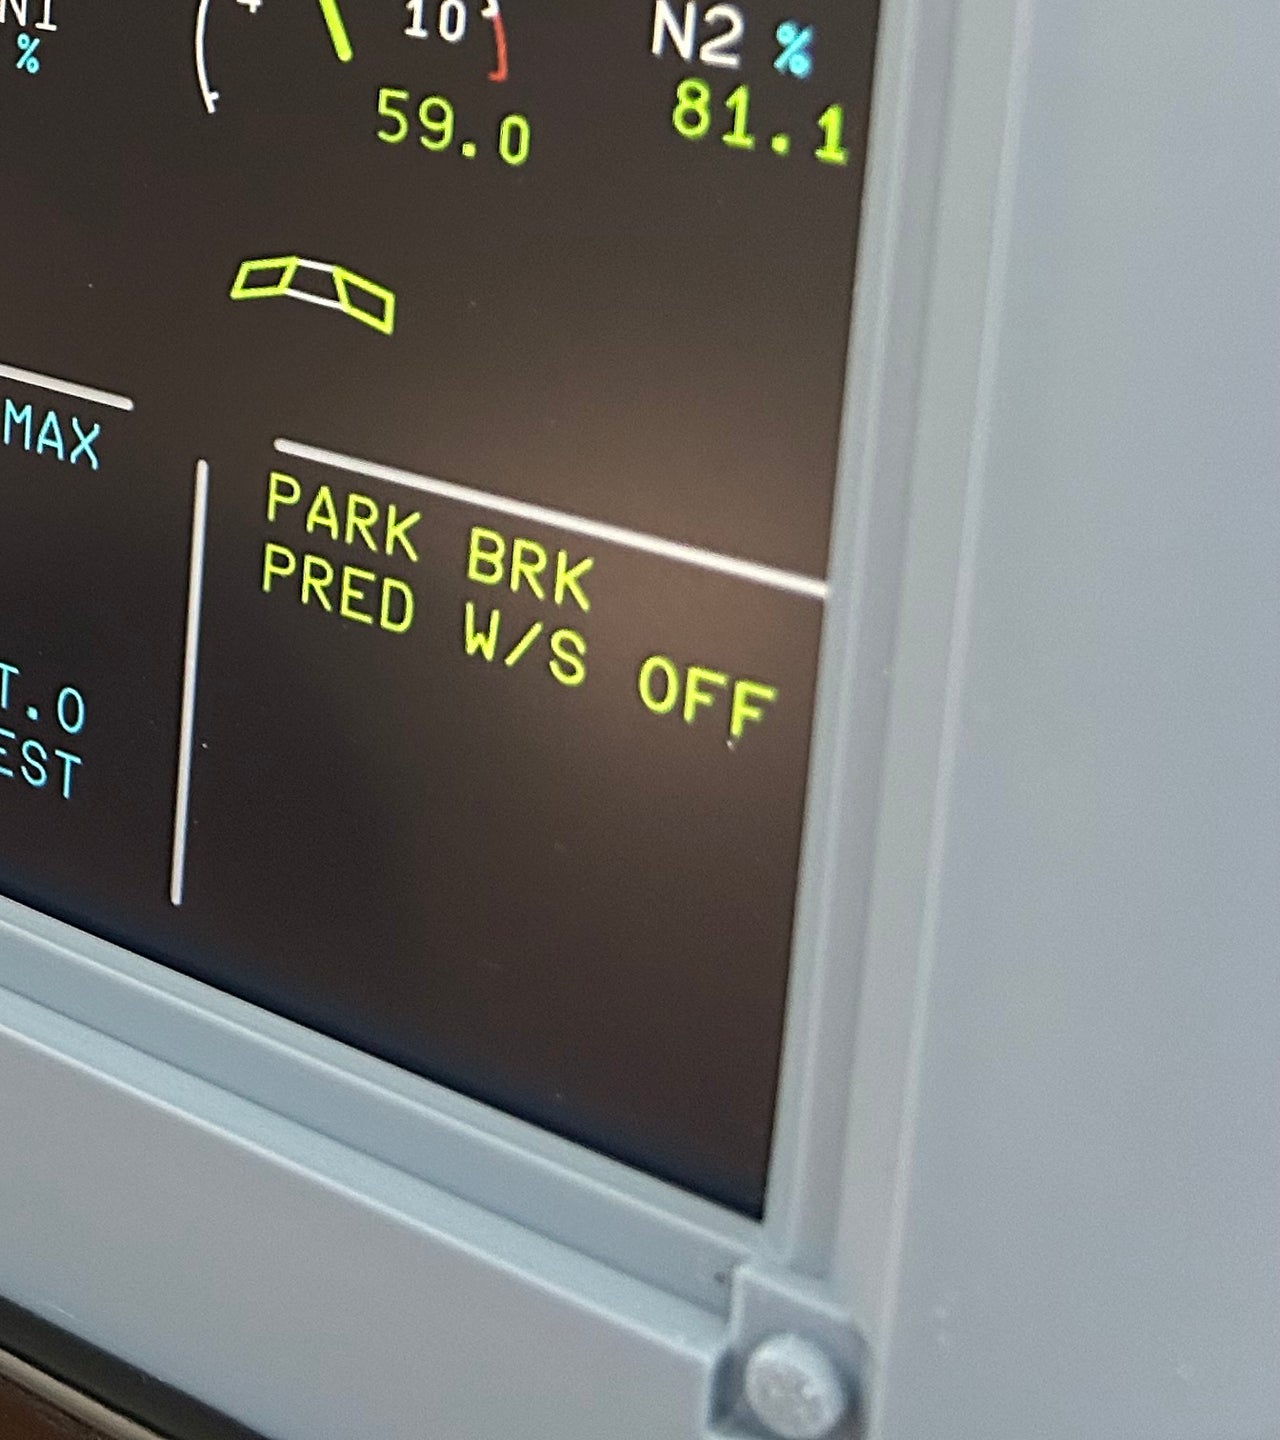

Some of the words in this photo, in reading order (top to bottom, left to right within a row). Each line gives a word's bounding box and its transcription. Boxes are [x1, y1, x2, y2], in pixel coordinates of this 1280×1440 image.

[17, 34, 39, 73] %
[773, 20, 814, 77] %
[377, 88, 530, 164] 59.0
[672, 77, 848, 165] 81.1
[266, 471, 422, 563] PARK
[468, 526, 595, 612] BRK
[261, 543, 415, 634] PRED
[464, 601, 589, 687] W/S
[638, 654, 777, 738] OFF
